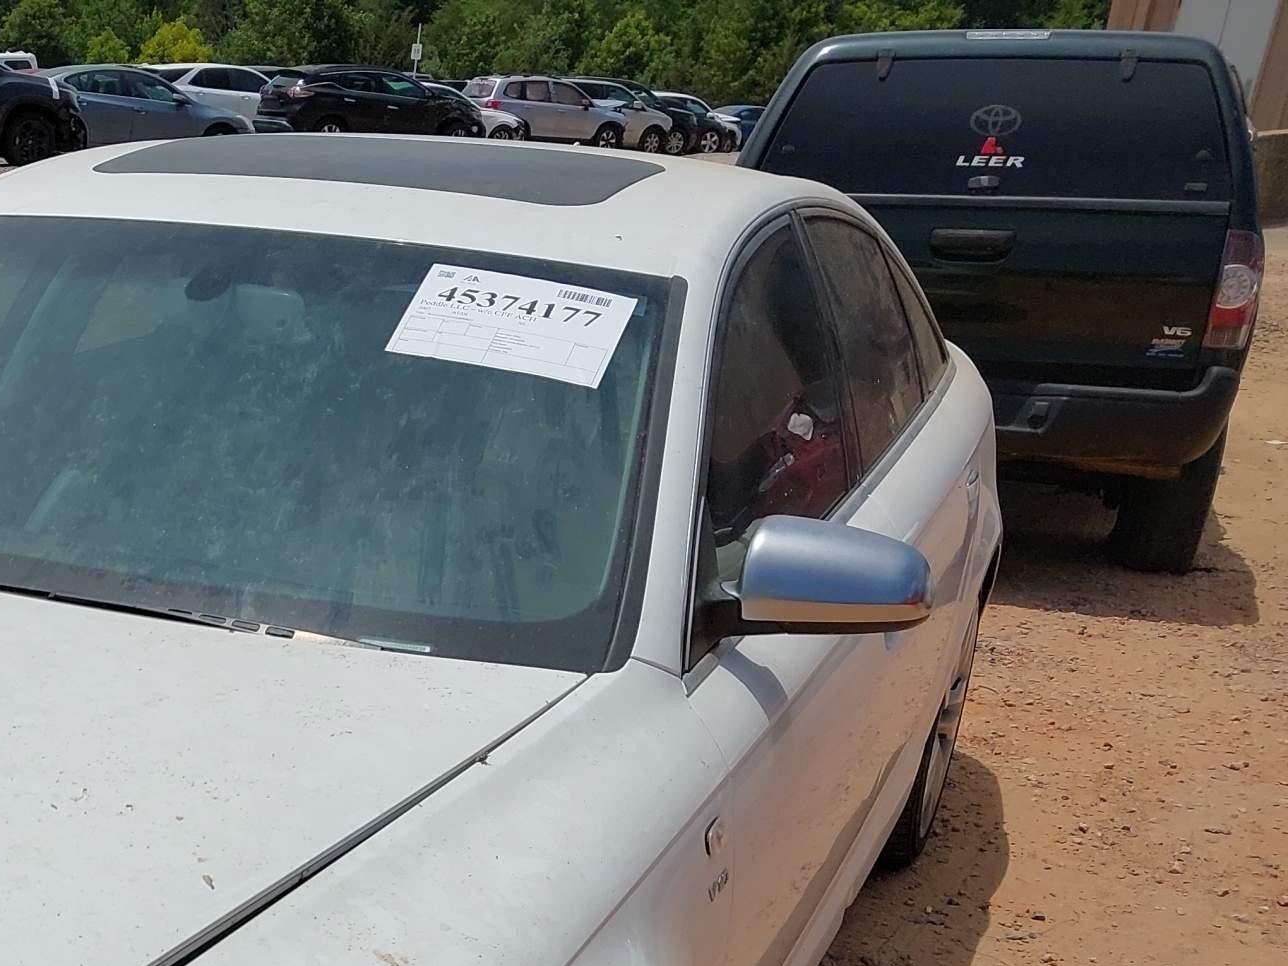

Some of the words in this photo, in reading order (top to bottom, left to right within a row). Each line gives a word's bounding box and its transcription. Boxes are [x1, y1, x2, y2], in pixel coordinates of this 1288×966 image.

[955, 155, 1025, 168] LEER
[437, 286, 603, 328] 45374177
[1162, 326, 1192, 337] V6
